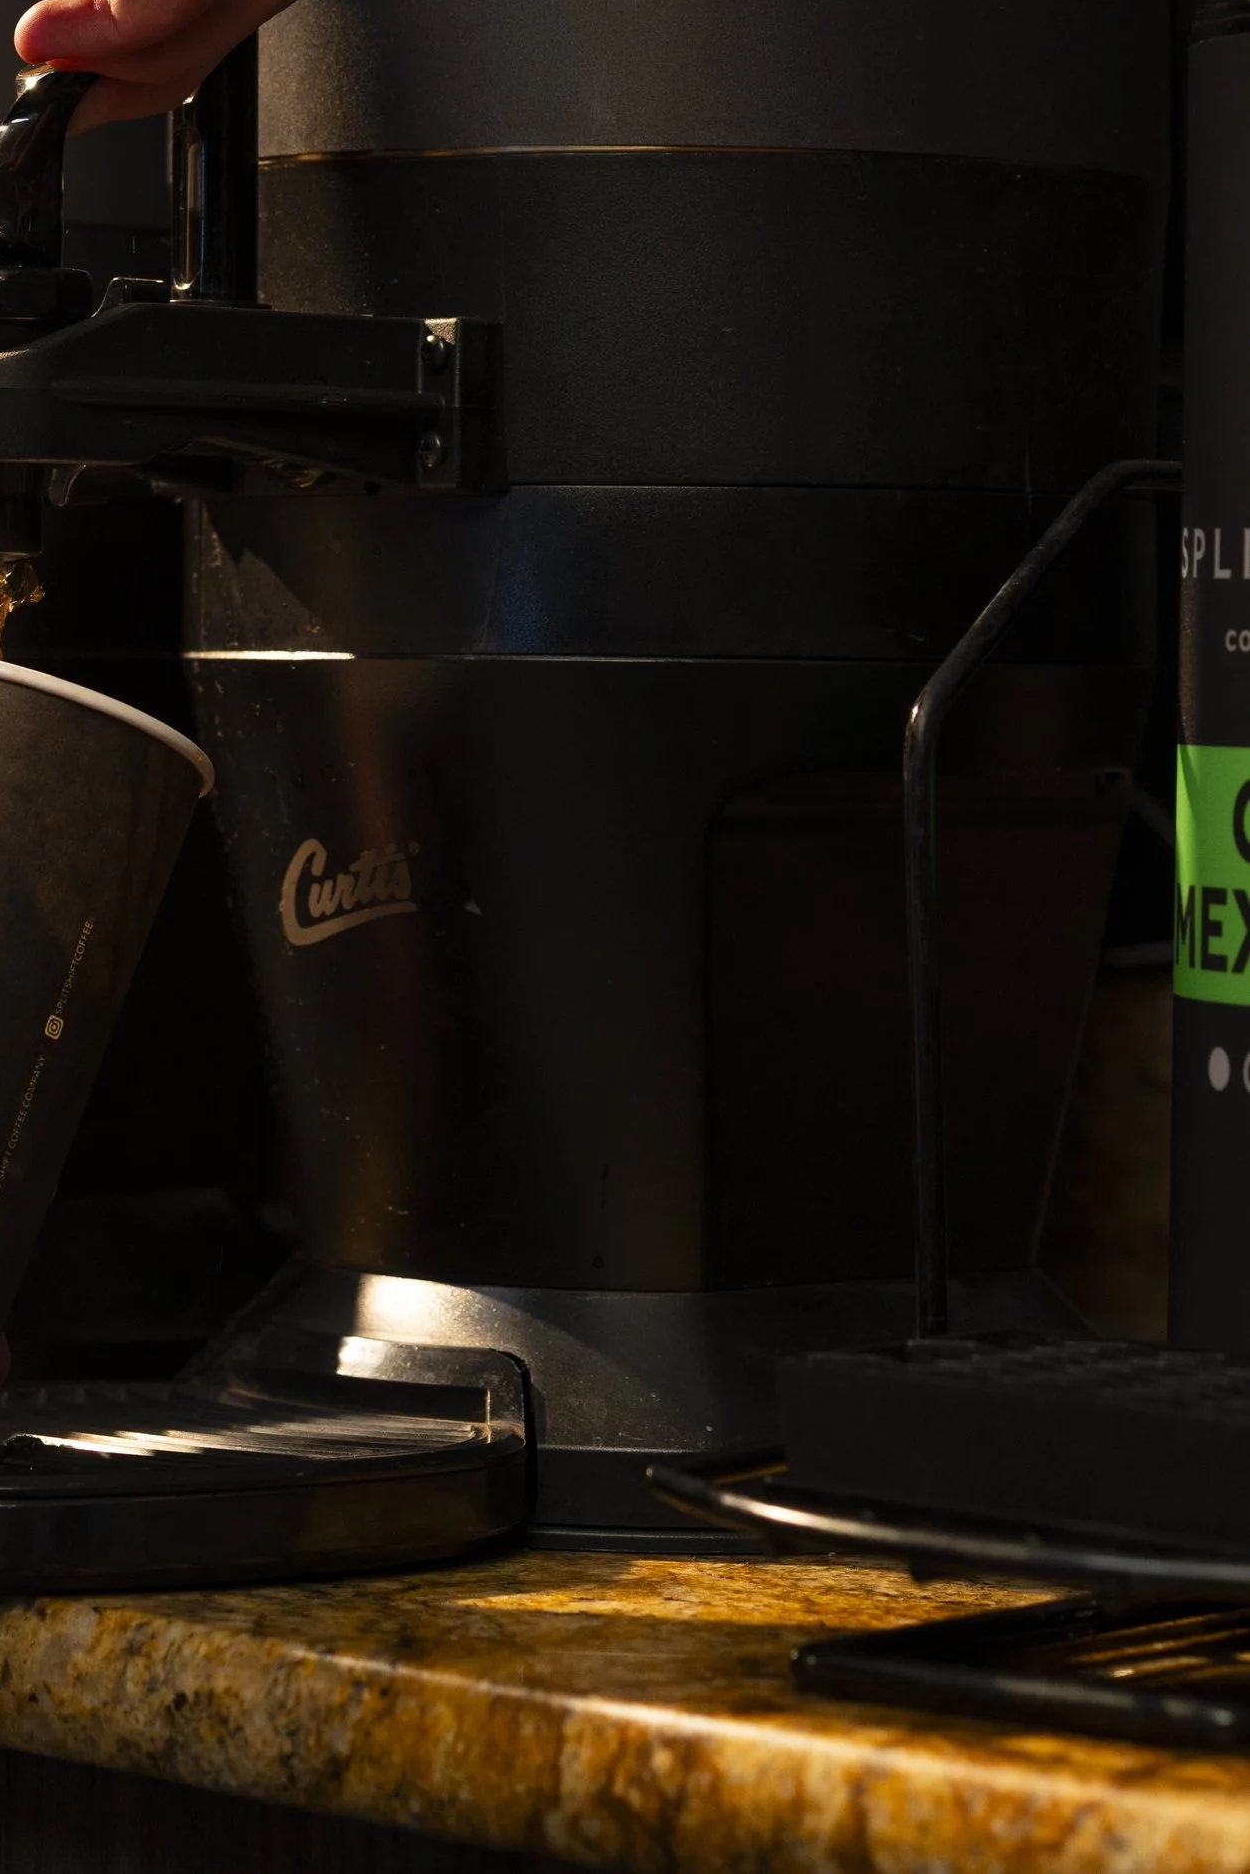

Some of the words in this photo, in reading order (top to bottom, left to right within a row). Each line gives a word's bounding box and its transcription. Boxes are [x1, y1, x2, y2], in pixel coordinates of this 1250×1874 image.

[280, 837, 419, 947] Curtis
[54, 919, 94, 1016] SPLITSHIFTCOFFEE
[8, 1109, 27, 1150] COFFEE
[21, 1054, 46, 1109] COMPANY
